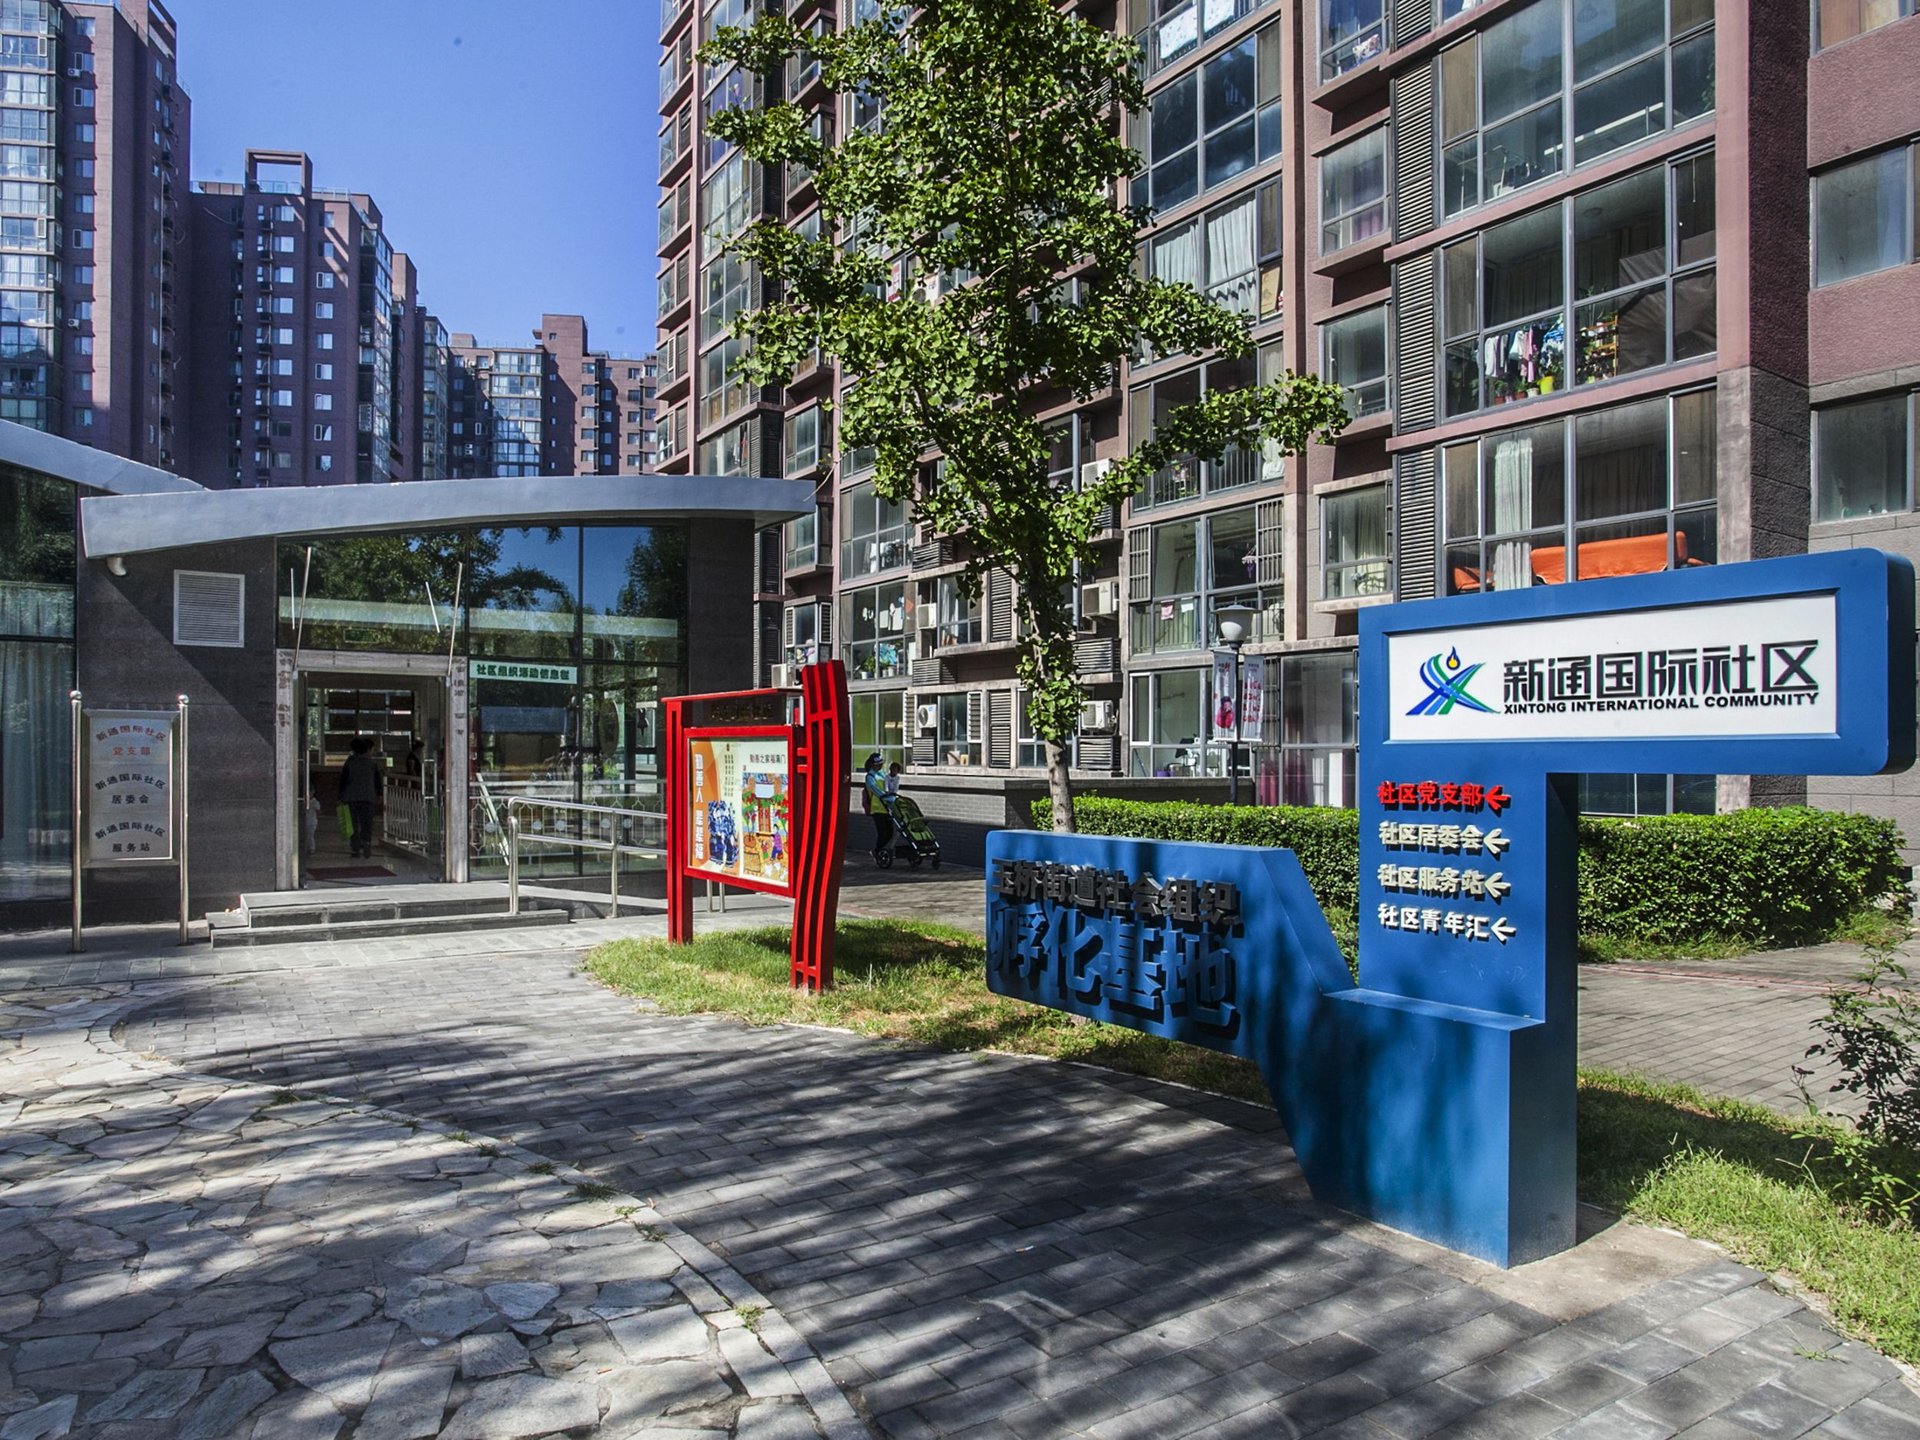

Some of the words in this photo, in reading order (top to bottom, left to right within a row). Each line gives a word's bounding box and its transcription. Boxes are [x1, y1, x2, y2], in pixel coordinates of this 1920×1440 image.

[1503, 639, 1819, 703] 新通国际社区
[1503, 702, 1567, 714] XINTONG
[1571, 697, 1699, 713] INTERNATIONAL
[1704, 692, 1819, 709] COMMUNITY
[95, 725, 167, 742] 新通国际社区
[112, 746, 151, 756] 党支部
[94, 773, 166, 791] 新通国际社区
[1377, 780, 1484, 806] 社区党支部
[111, 794, 150, 804] 居委会
[94, 821, 166, 840] 新通国际社区
[1378, 820, 1485, 849] 社区居委会
[112, 843, 151, 853] 服务站
[1377, 863, 1486, 895] 社区服务站
[1377, 902, 1491, 938] 社区青年汇
[990, 899, 1239, 1028] 孵化基地
